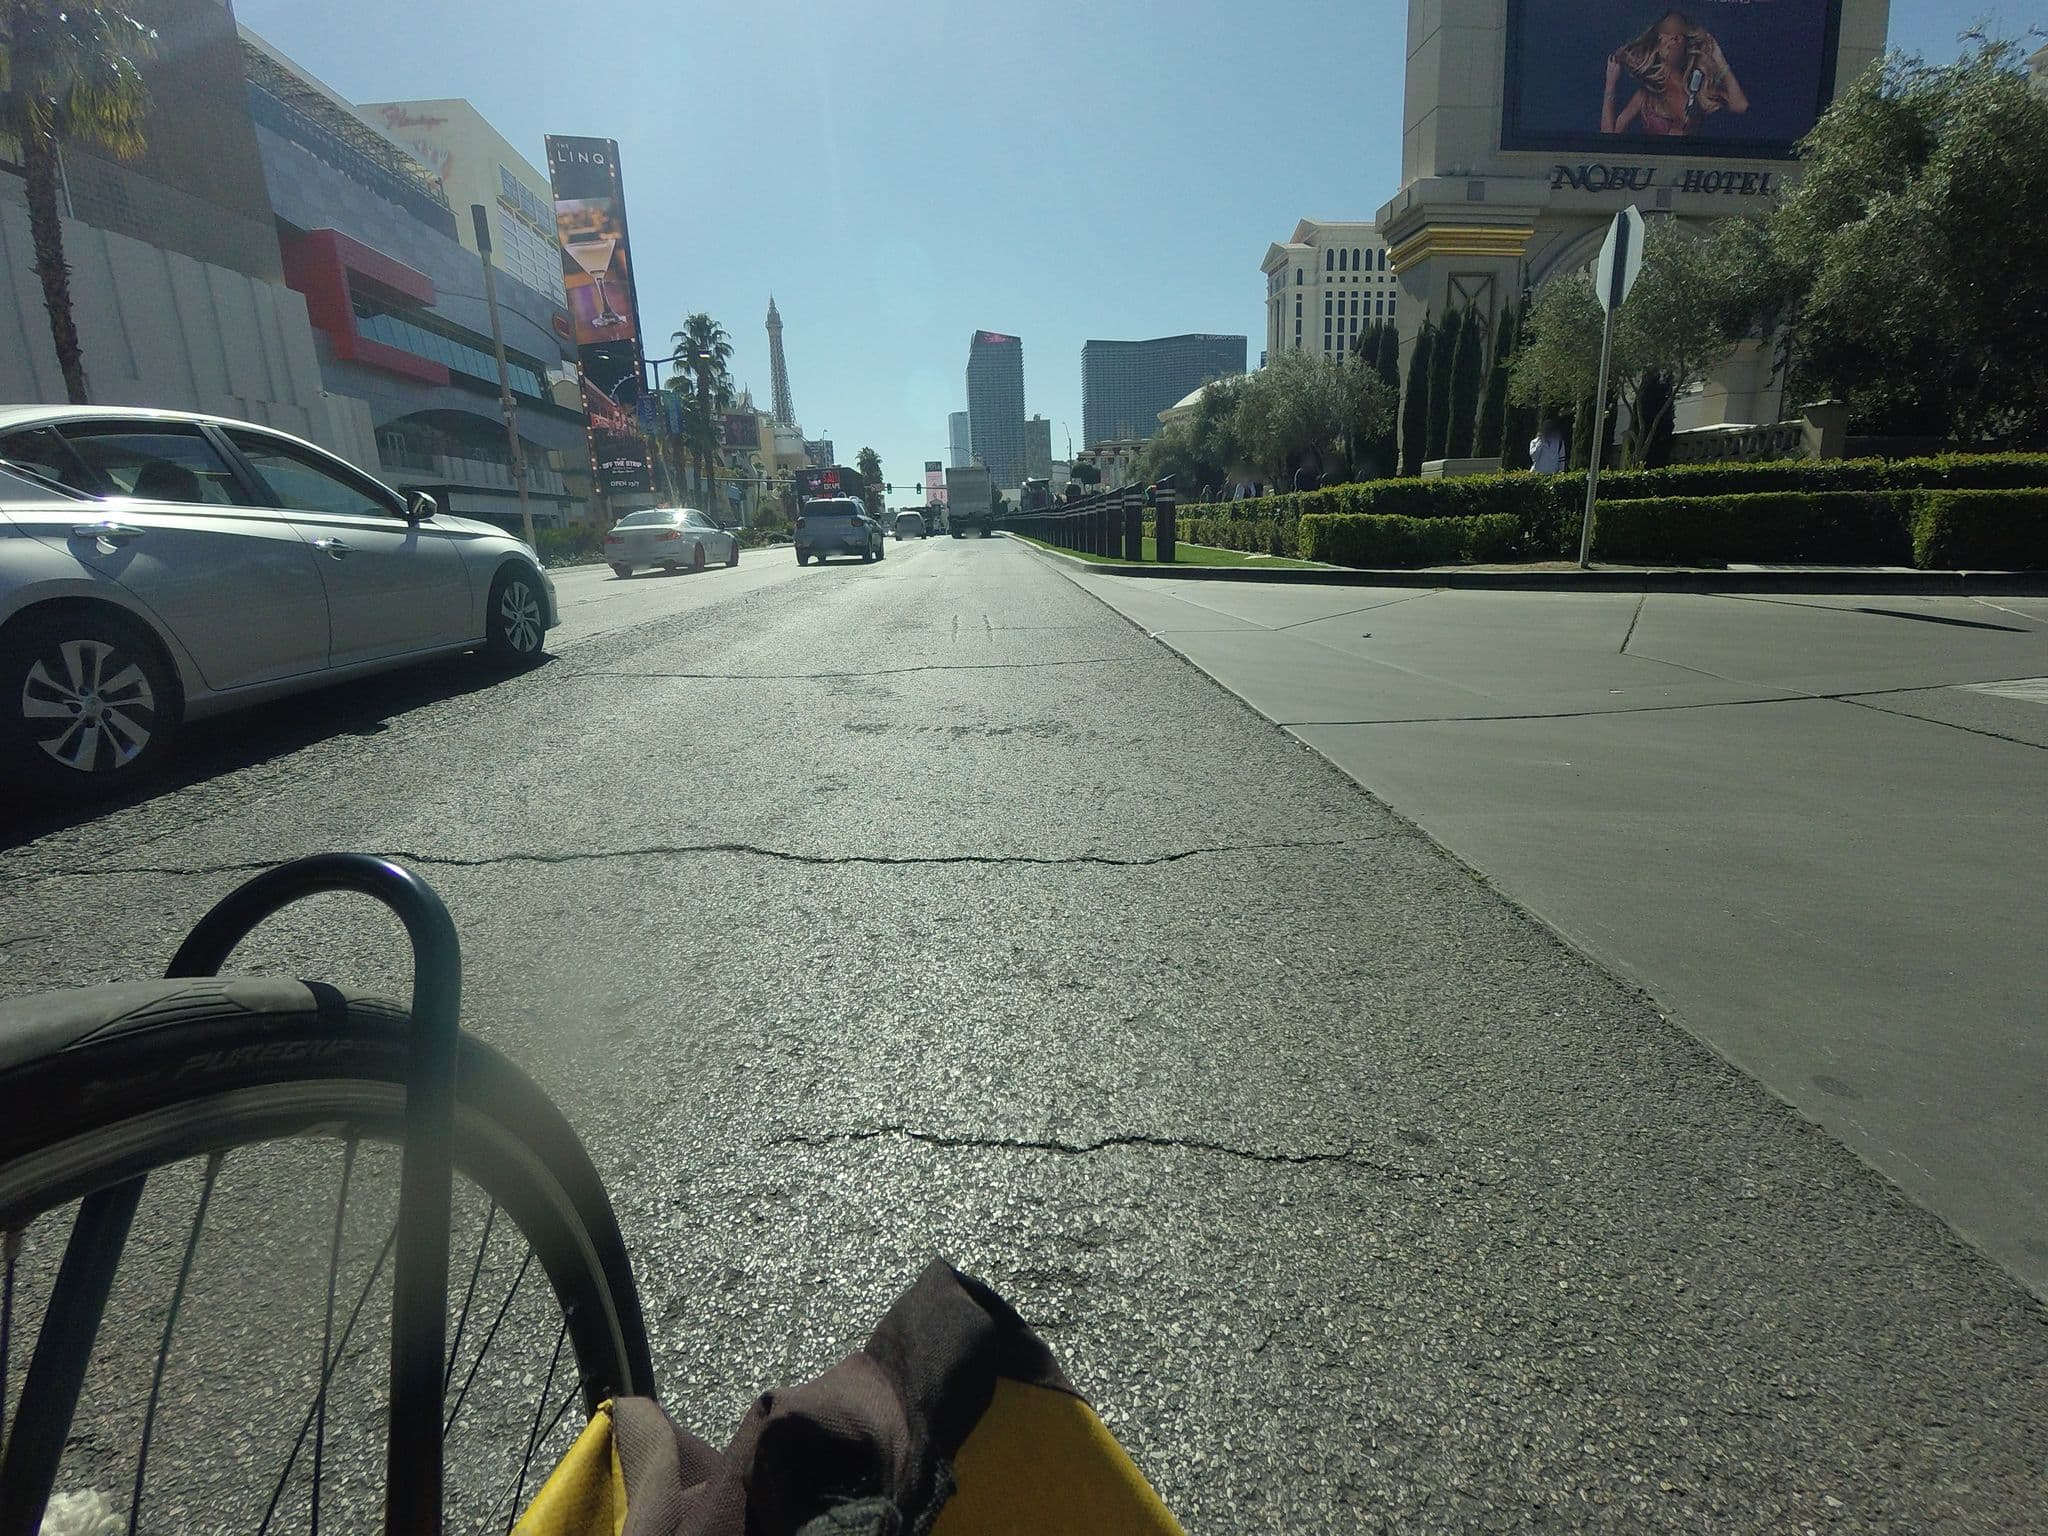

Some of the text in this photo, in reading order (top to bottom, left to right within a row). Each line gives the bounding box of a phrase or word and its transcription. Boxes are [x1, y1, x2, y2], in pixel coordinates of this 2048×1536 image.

[557, 151, 605, 165] LINQ
[1551, 164, 1657, 193] NOBU
[625, 460, 642, 468] STRIP
